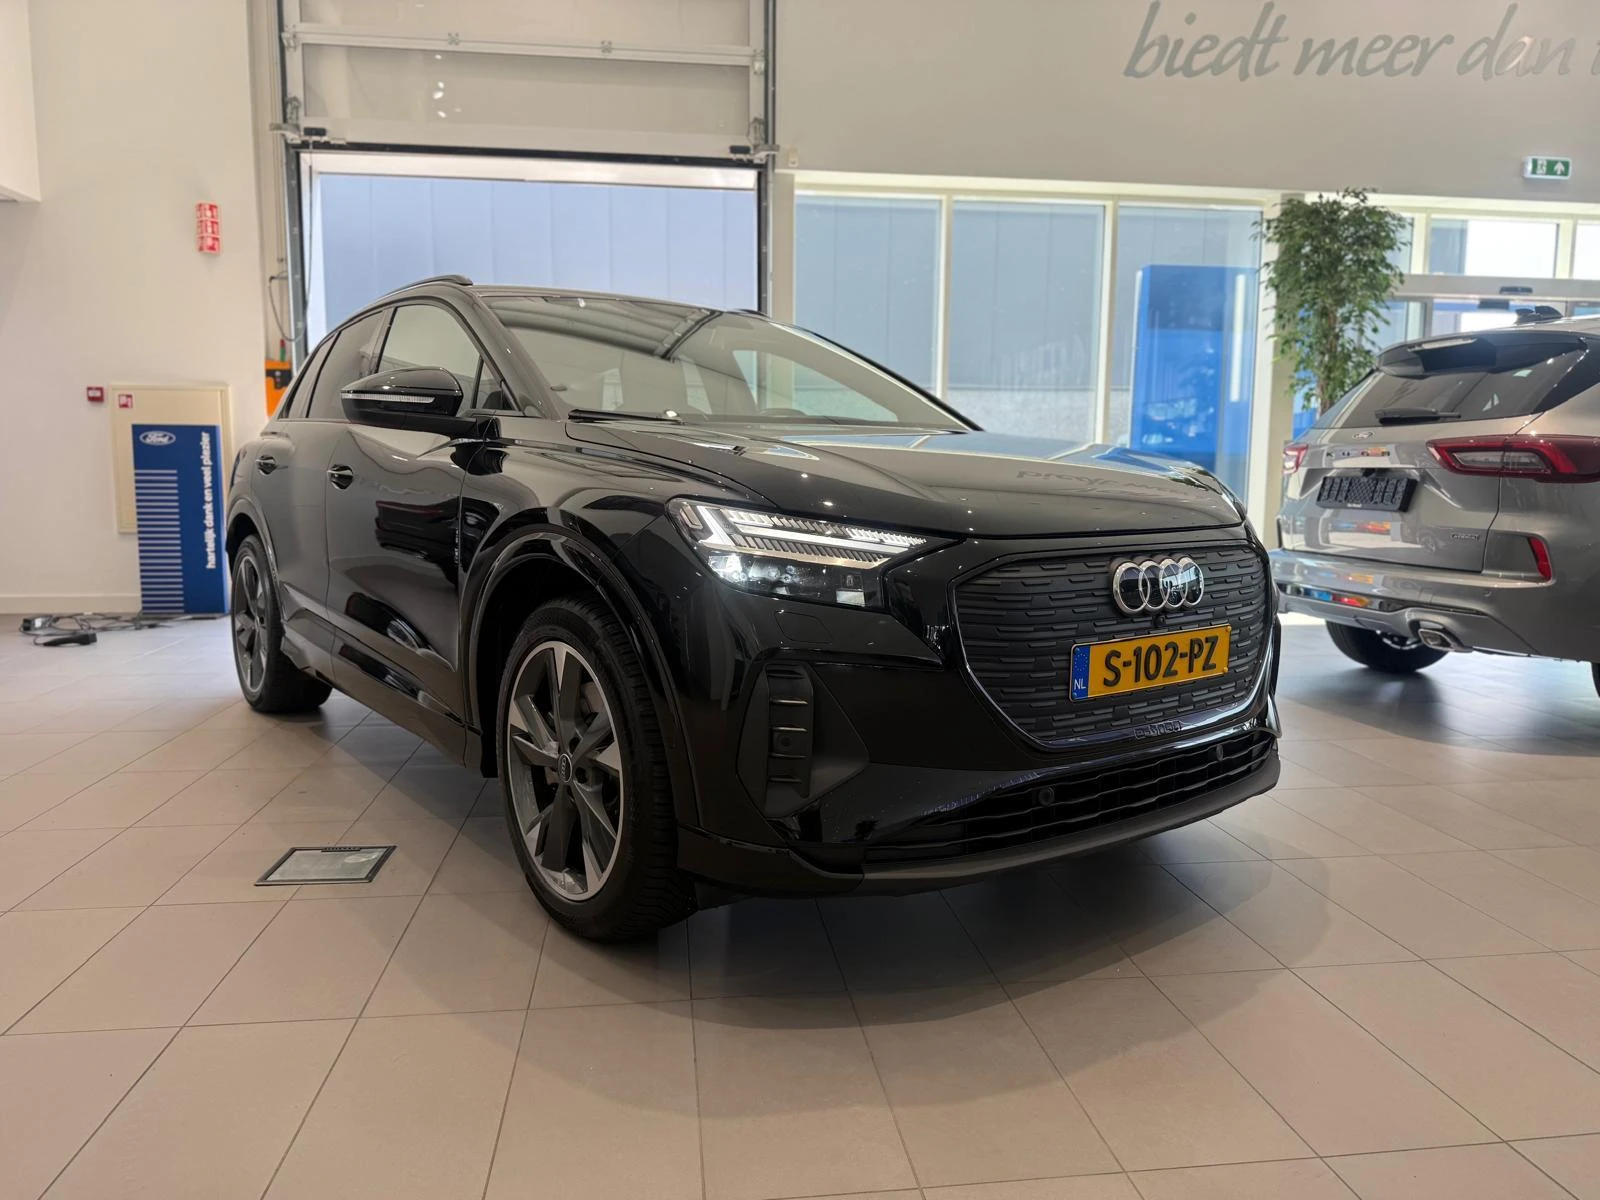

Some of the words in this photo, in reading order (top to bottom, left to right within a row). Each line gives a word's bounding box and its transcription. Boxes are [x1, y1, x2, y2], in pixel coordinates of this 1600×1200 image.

[1123, 1, 1288, 82] biedt
[1294, 33, 1454, 77] meer
[1457, 3, 1576, 82] dan
[143, 431, 172, 446] Ford
[201, 466, 212, 488] veel
[204, 488, 212, 502] en
[203, 502, 214, 528] dank
[1073, 678, 1087, 690] NL
[1103, 635, 1219, 688] S-102-PZ
